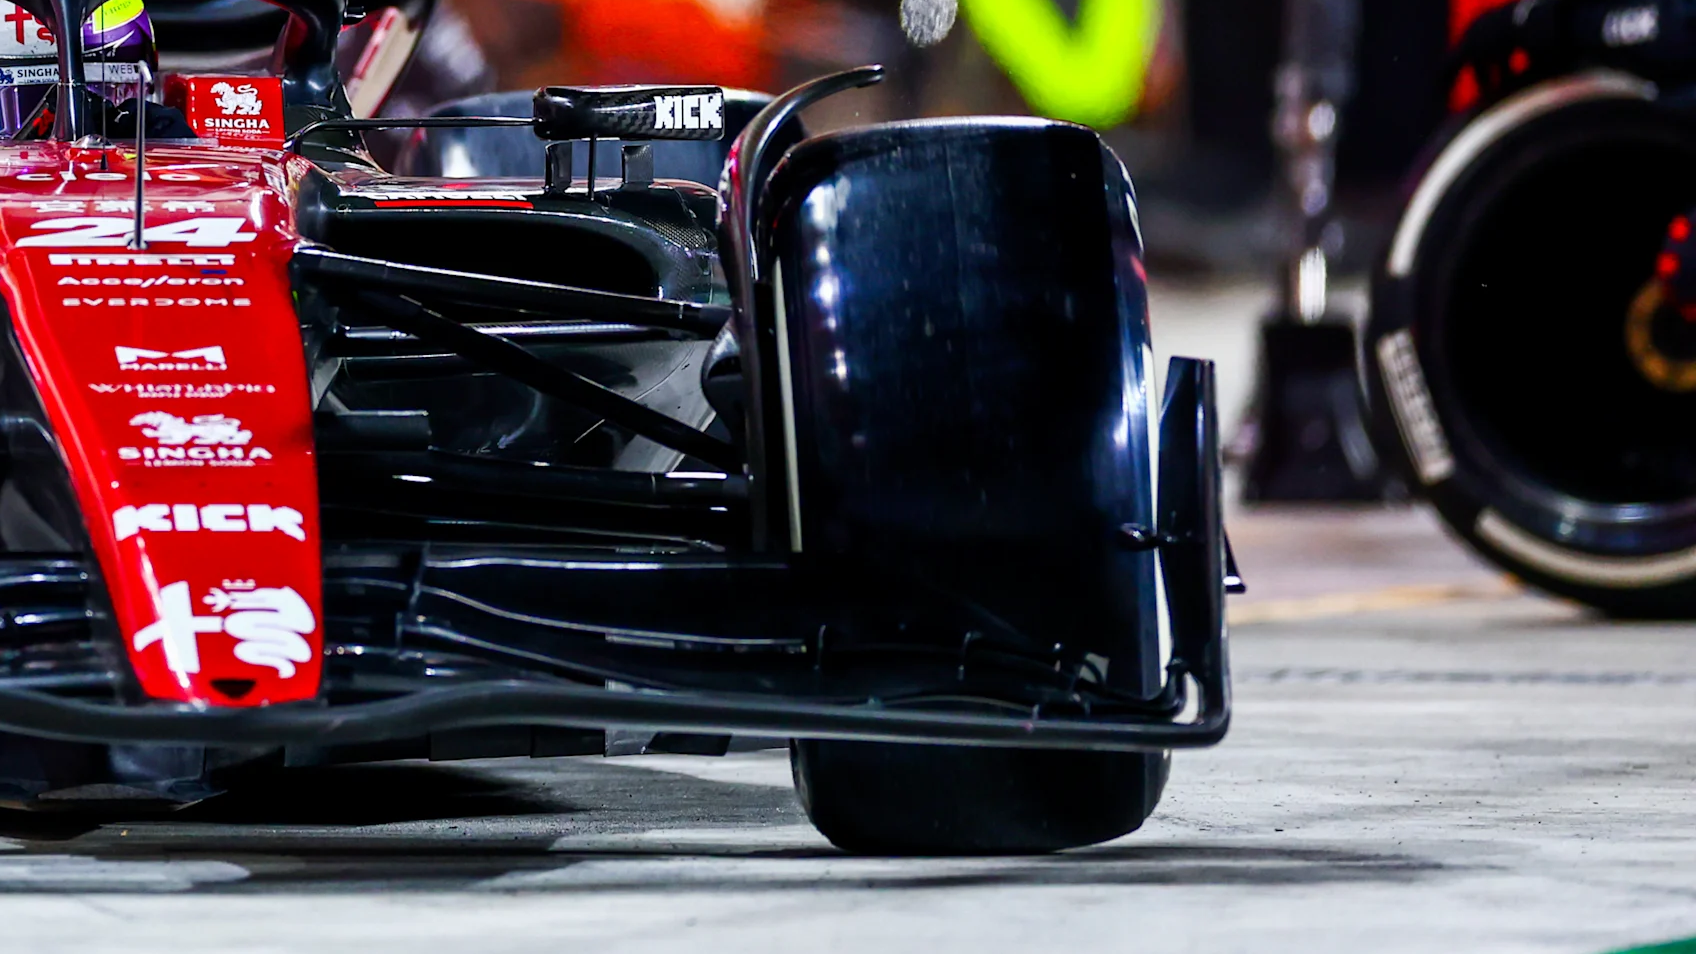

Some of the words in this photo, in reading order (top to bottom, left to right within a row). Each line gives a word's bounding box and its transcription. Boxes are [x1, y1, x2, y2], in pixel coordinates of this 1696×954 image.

[17, 68, 60, 78] SINGHA
[654, 92, 724, 130] KICK
[204, 117, 270, 129] SINGHA
[15, 217, 257, 247] 24
[62, 297, 252, 307] EVERDOME
[117, 446, 273, 460] SINGHA
[112, 503, 306, 542] KICK
